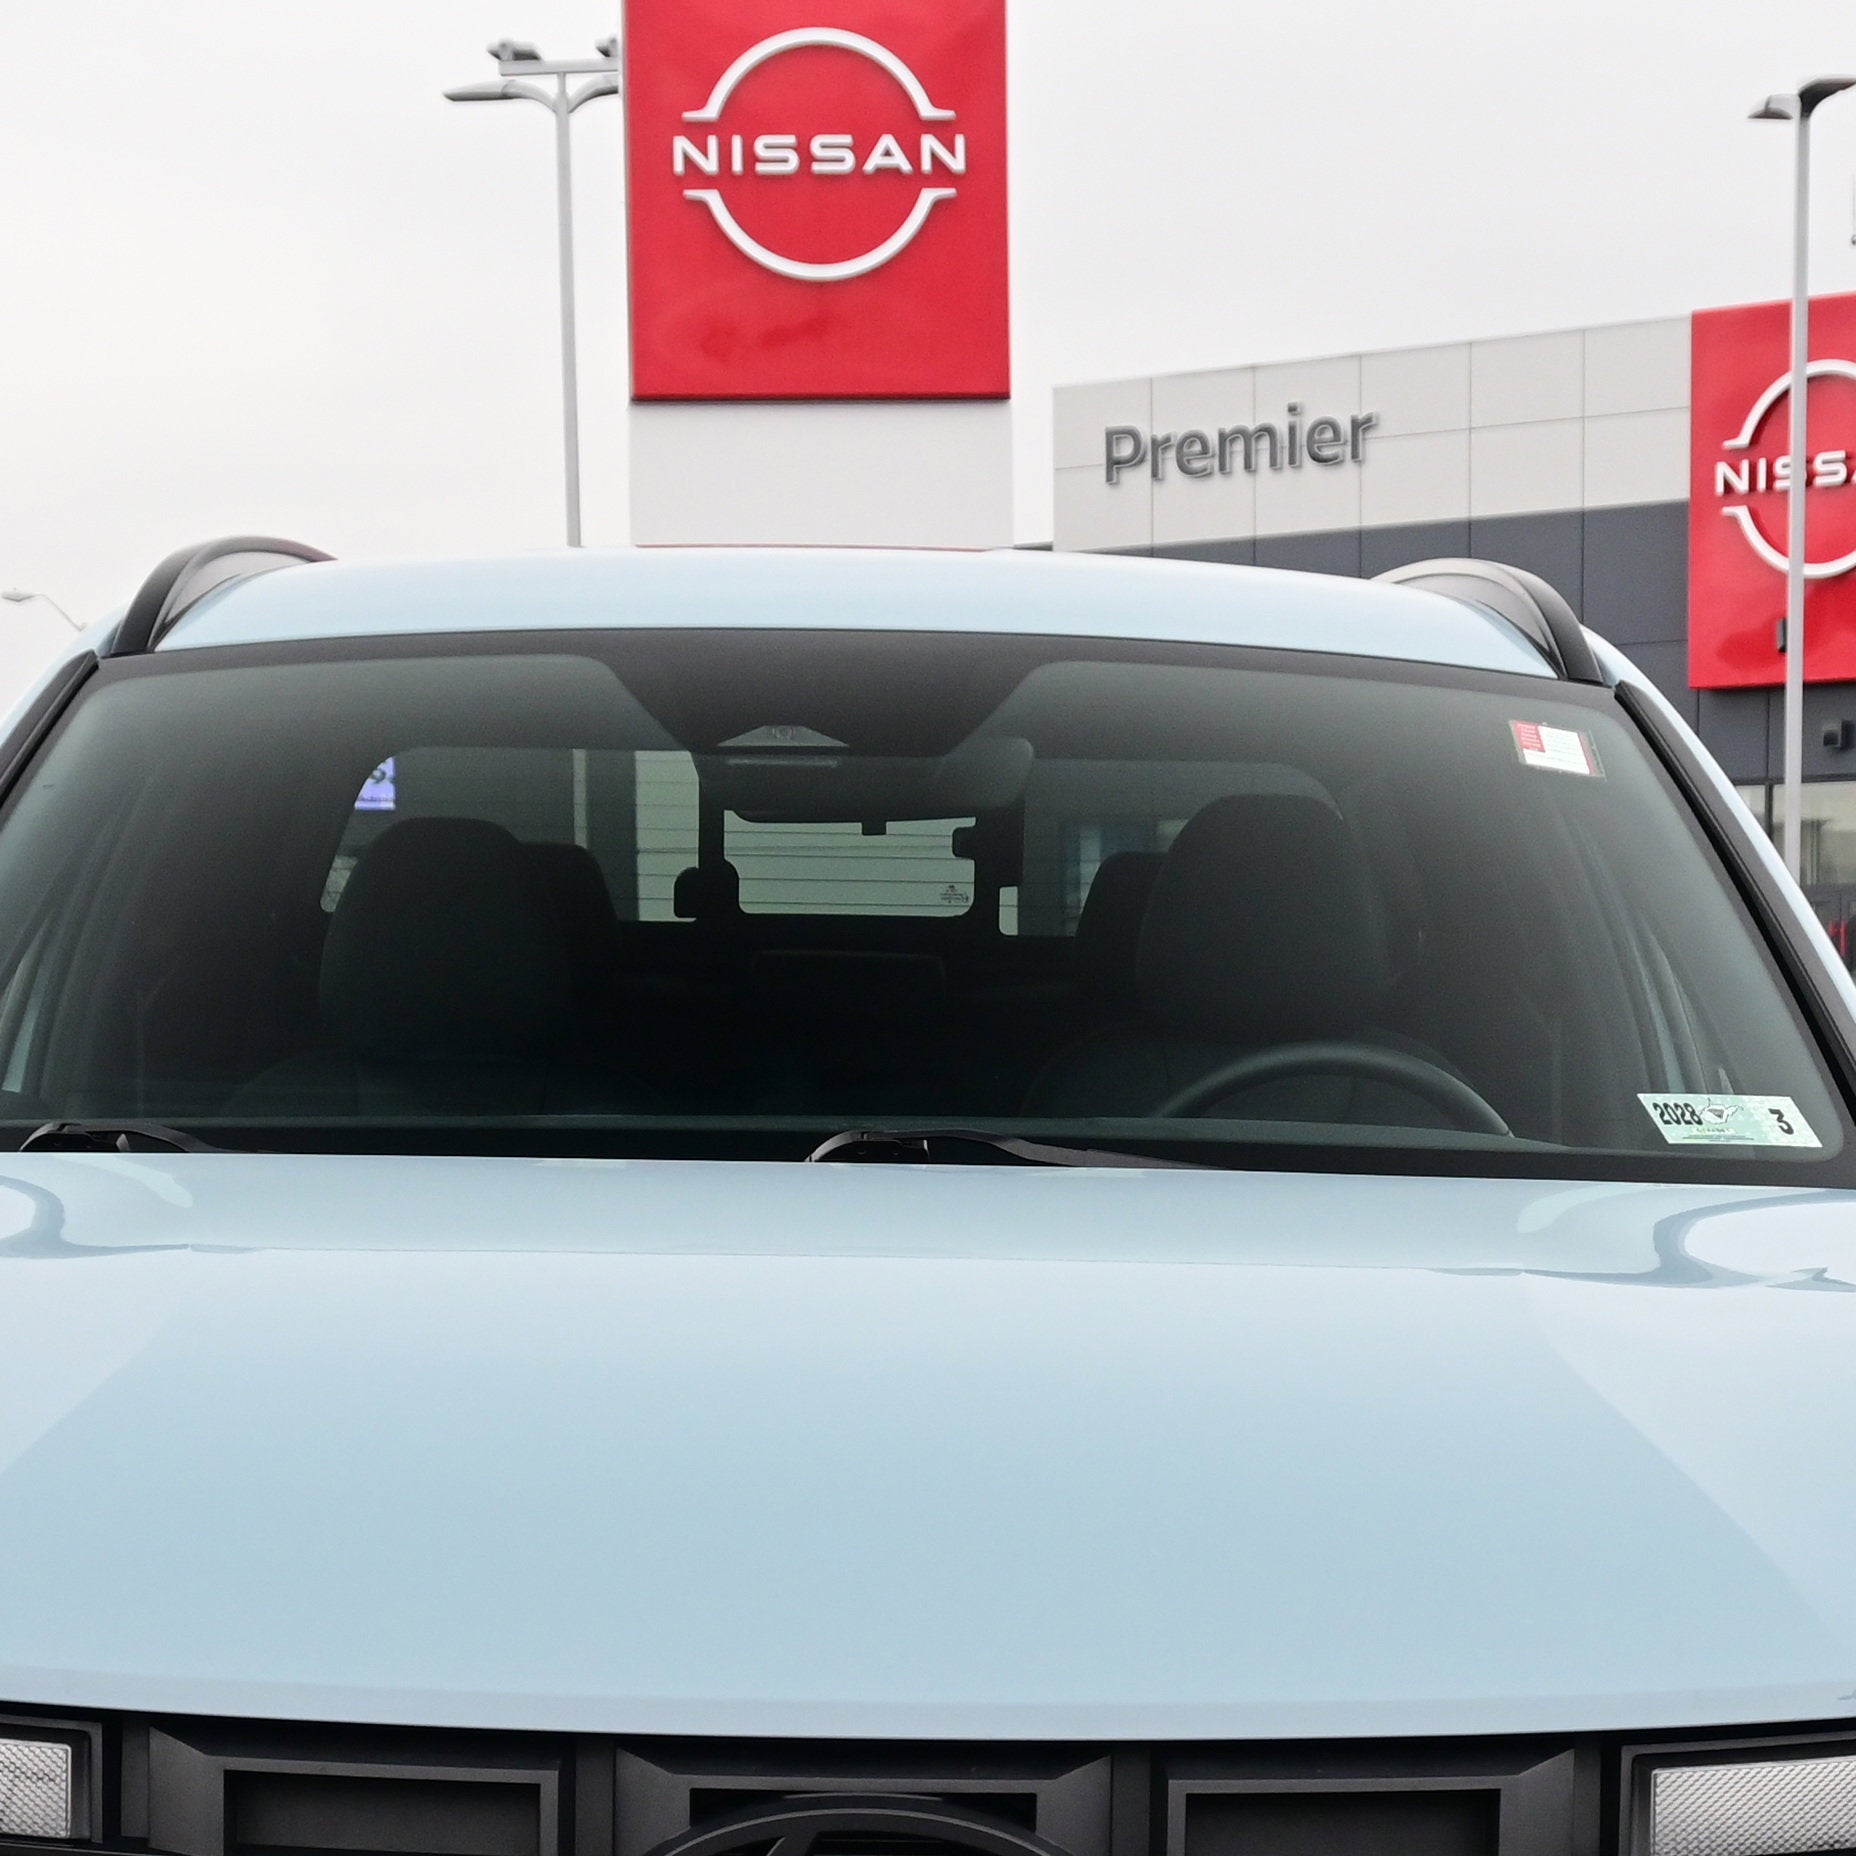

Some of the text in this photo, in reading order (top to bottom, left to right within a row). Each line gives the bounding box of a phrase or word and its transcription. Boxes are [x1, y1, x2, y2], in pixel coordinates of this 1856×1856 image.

[672, 133, 966, 176] NISSAN
[1104, 401, 1379, 485] Premier
[1652, 1102, 1794, 1135] 2028 3
